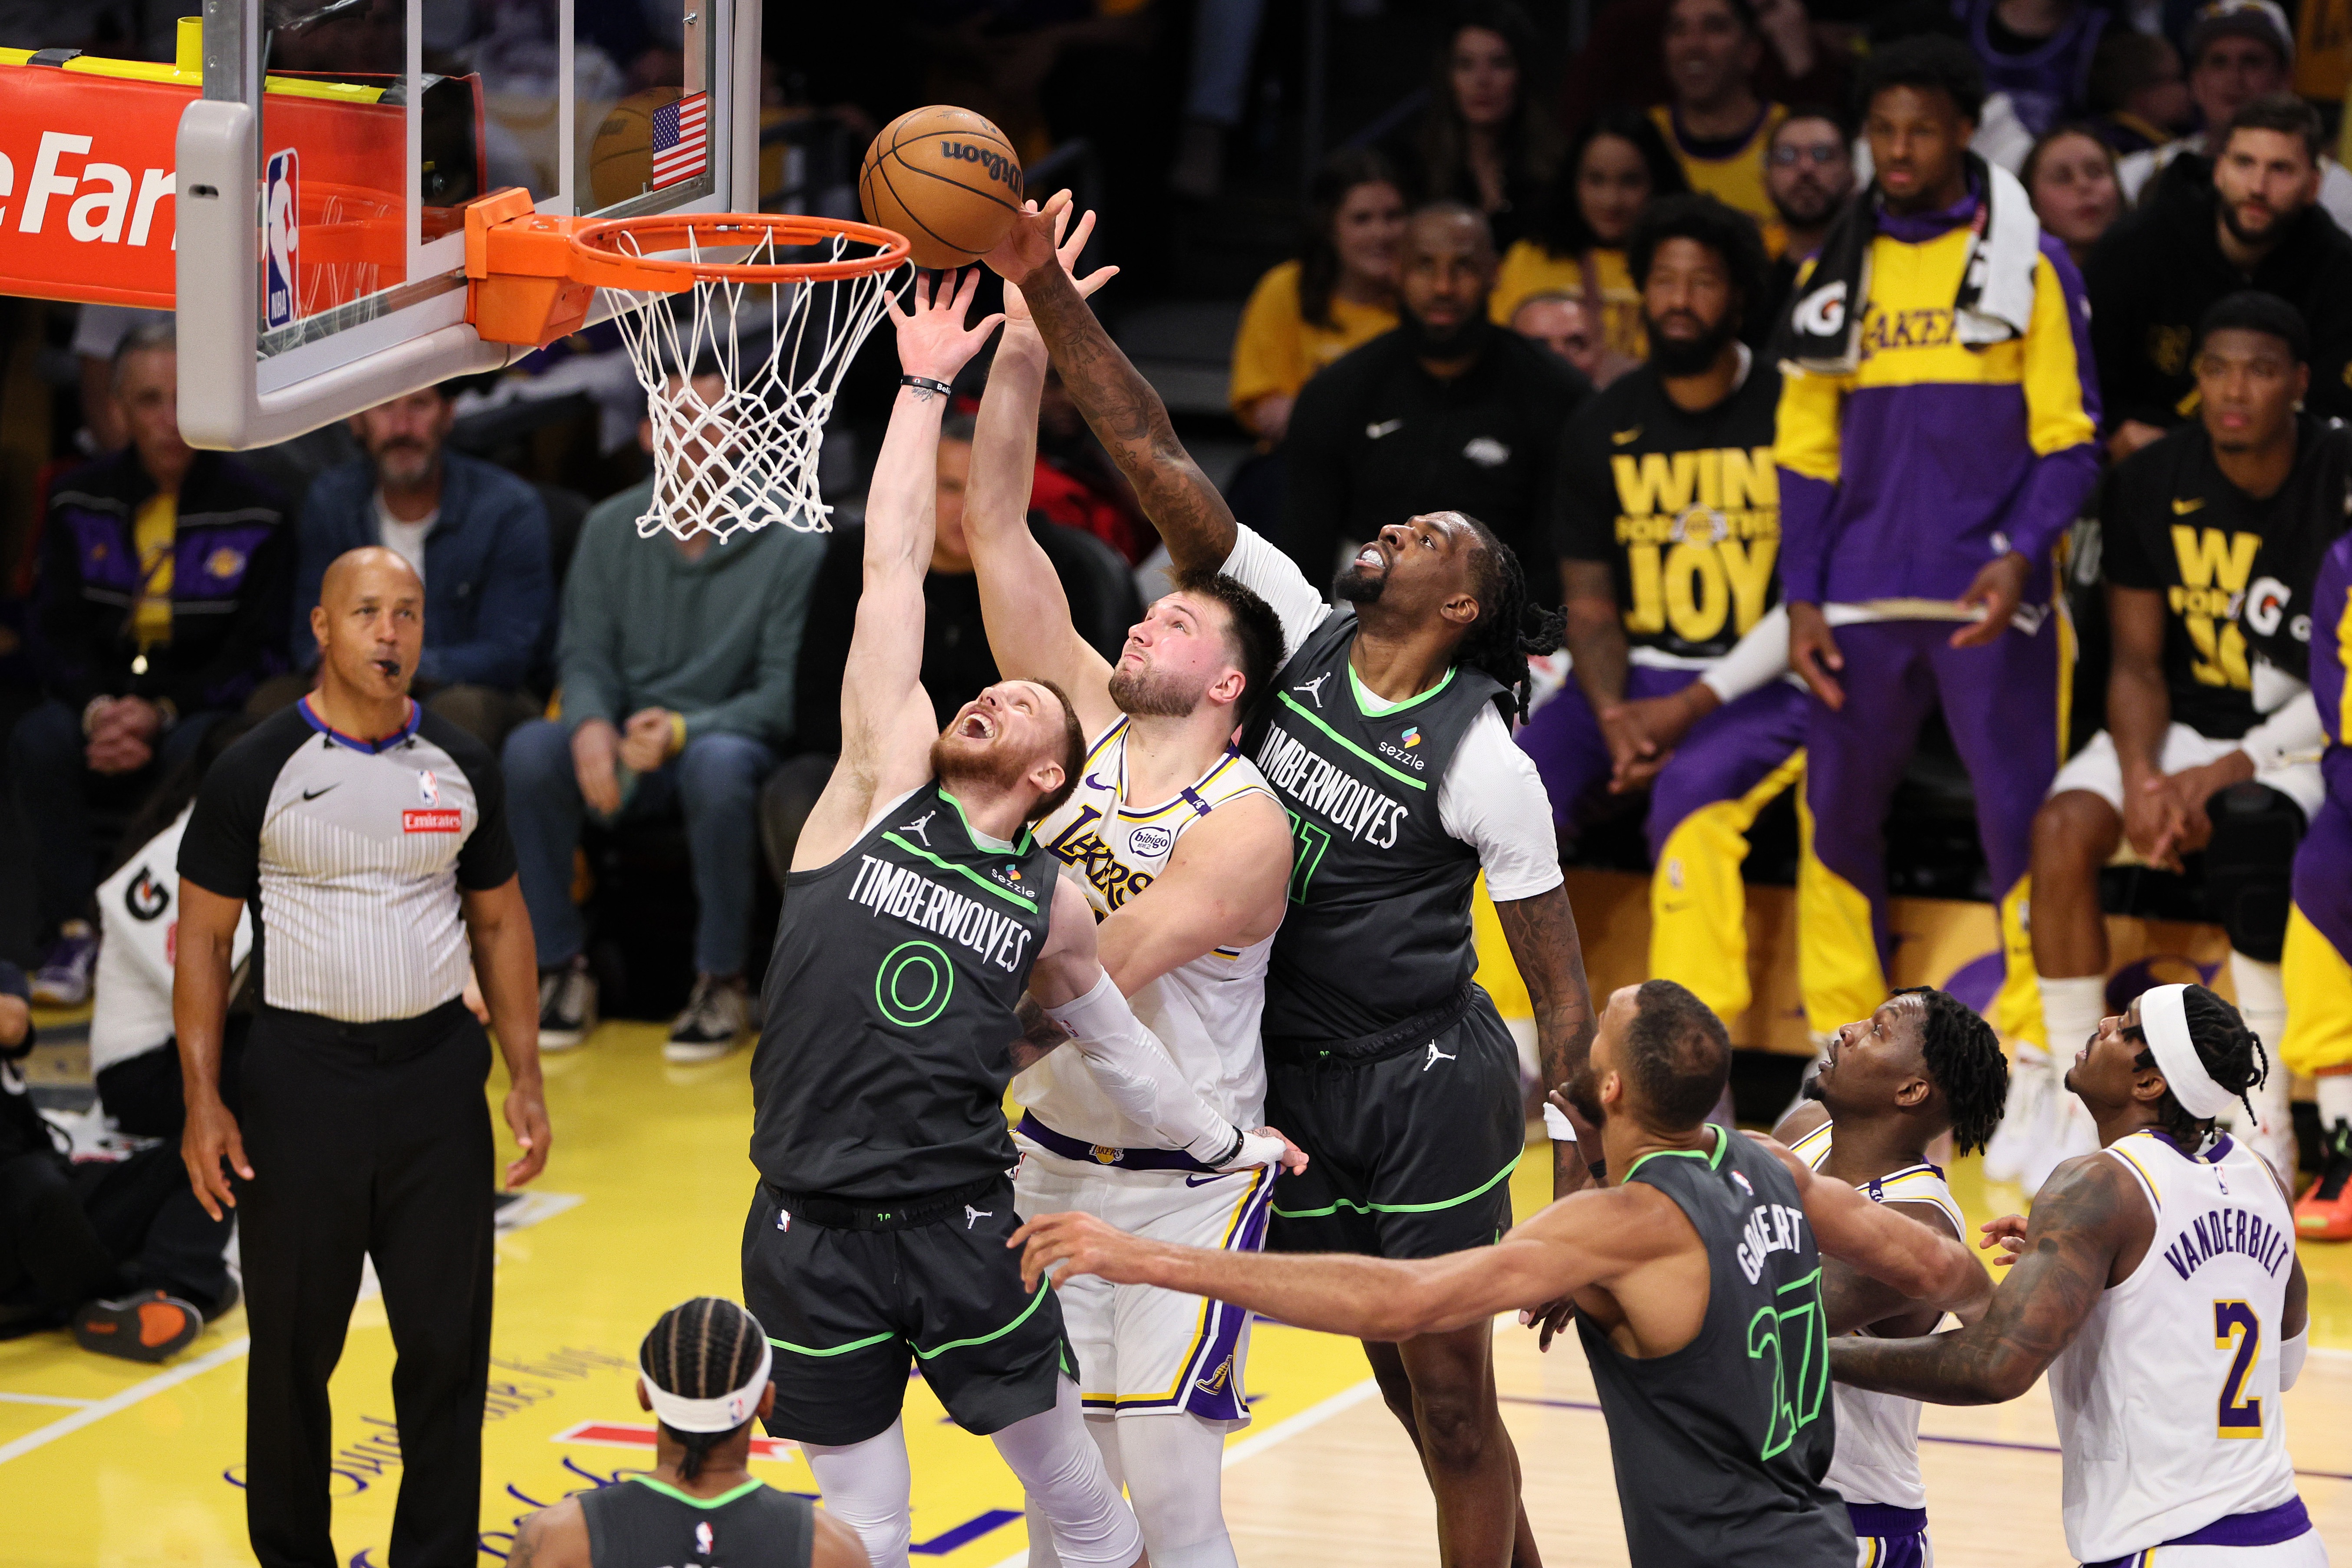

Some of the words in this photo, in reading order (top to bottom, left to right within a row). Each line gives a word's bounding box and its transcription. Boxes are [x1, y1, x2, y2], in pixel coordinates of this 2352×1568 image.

[19, 131, 176, 251] Far
[271, 288, 287, 320] NBA
[1611, 446, 1779, 514] WIN
[1624, 540, 1779, 642] JOY
[2244, 576, 2293, 637] G
[1256, 719, 1409, 850] TIMBERWOLVES
[1379, 739, 1425, 771] sezzle
[1134, 832, 1168, 849] bibigo
[125, 866, 170, 921] G
[848, 854, 1032, 973] TIMBERWOLVES
[992, 868, 1035, 898] sezzle
[876, 940, 954, 1027] 0
[1090, 1144, 1124, 1161] LAKERS
[2164, 1208, 2289, 1281] VANDERBILT
[1748, 1266, 1829, 1461] 27
[2213, 1299, 2264, 1439] 2
